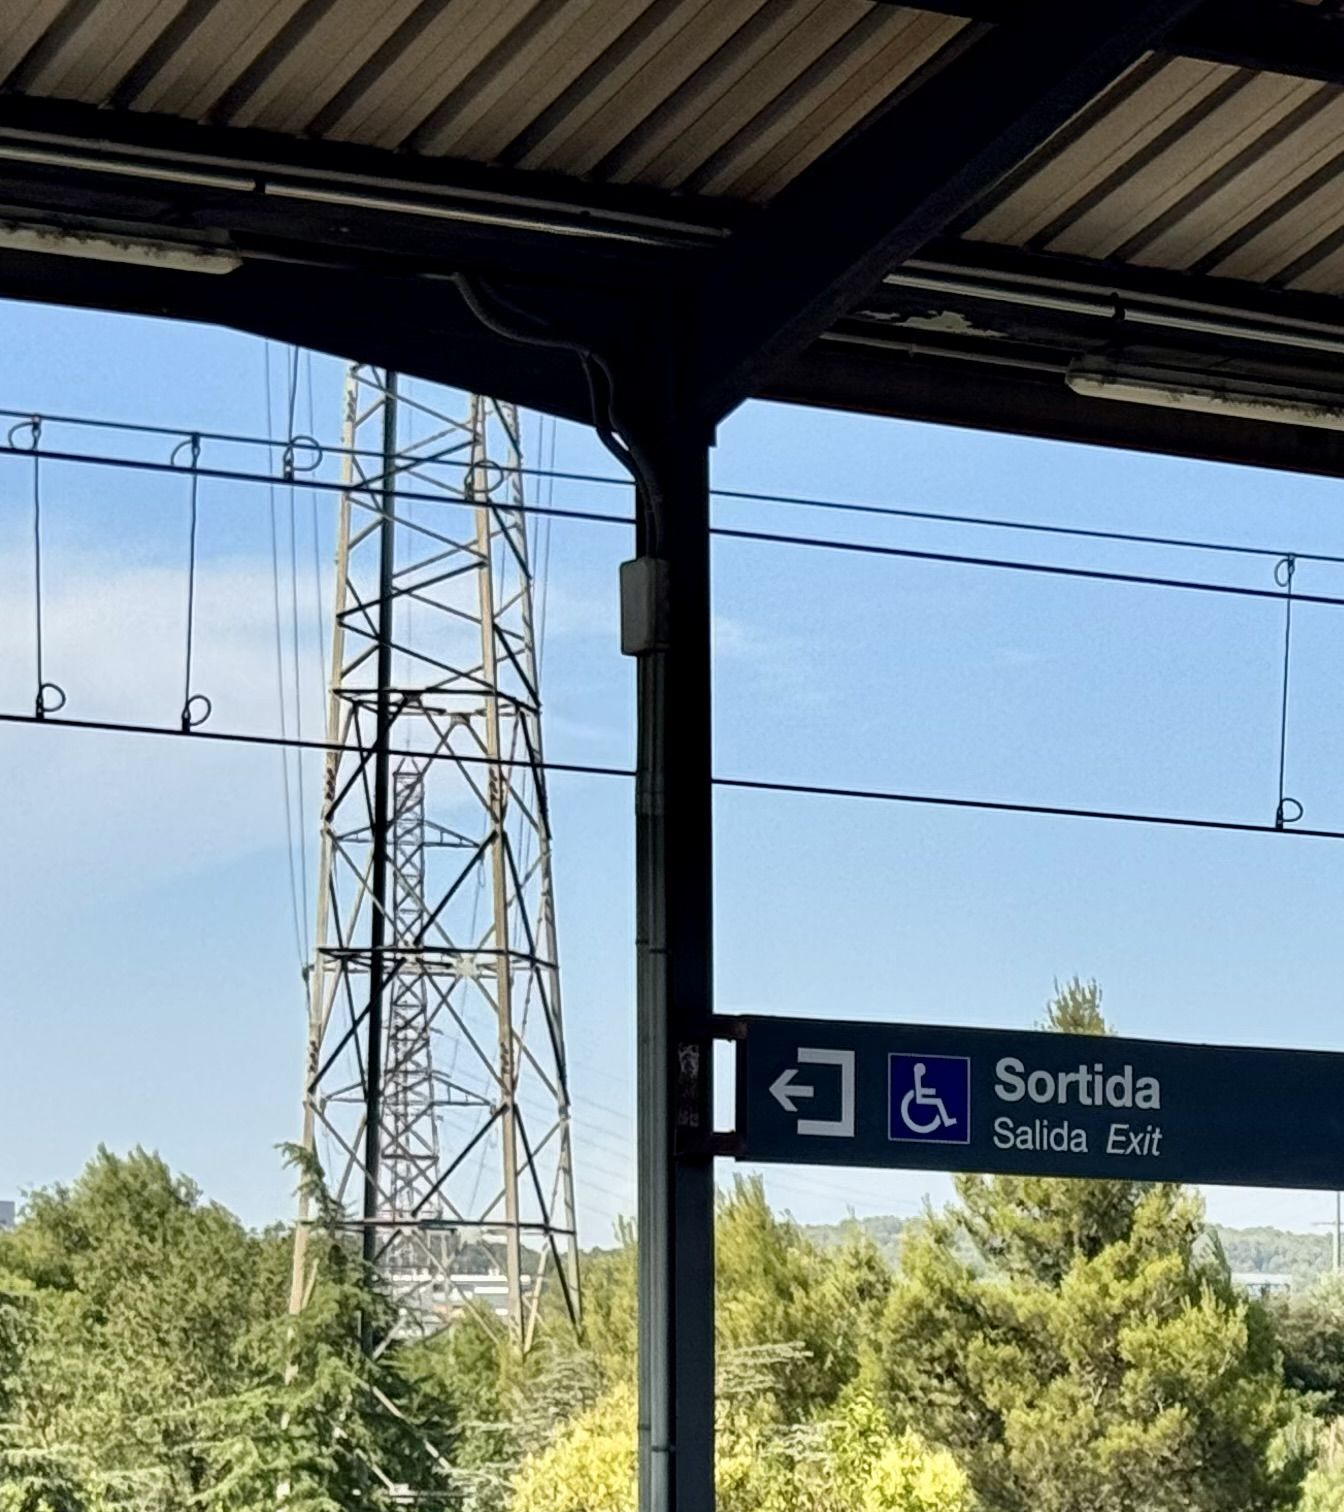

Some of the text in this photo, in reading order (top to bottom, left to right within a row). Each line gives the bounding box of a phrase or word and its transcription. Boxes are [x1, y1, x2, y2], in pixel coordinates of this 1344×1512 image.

[994, 1056, 1161, 1109] Sortida
[993, 1116, 1163, 1156] Salida Exit
